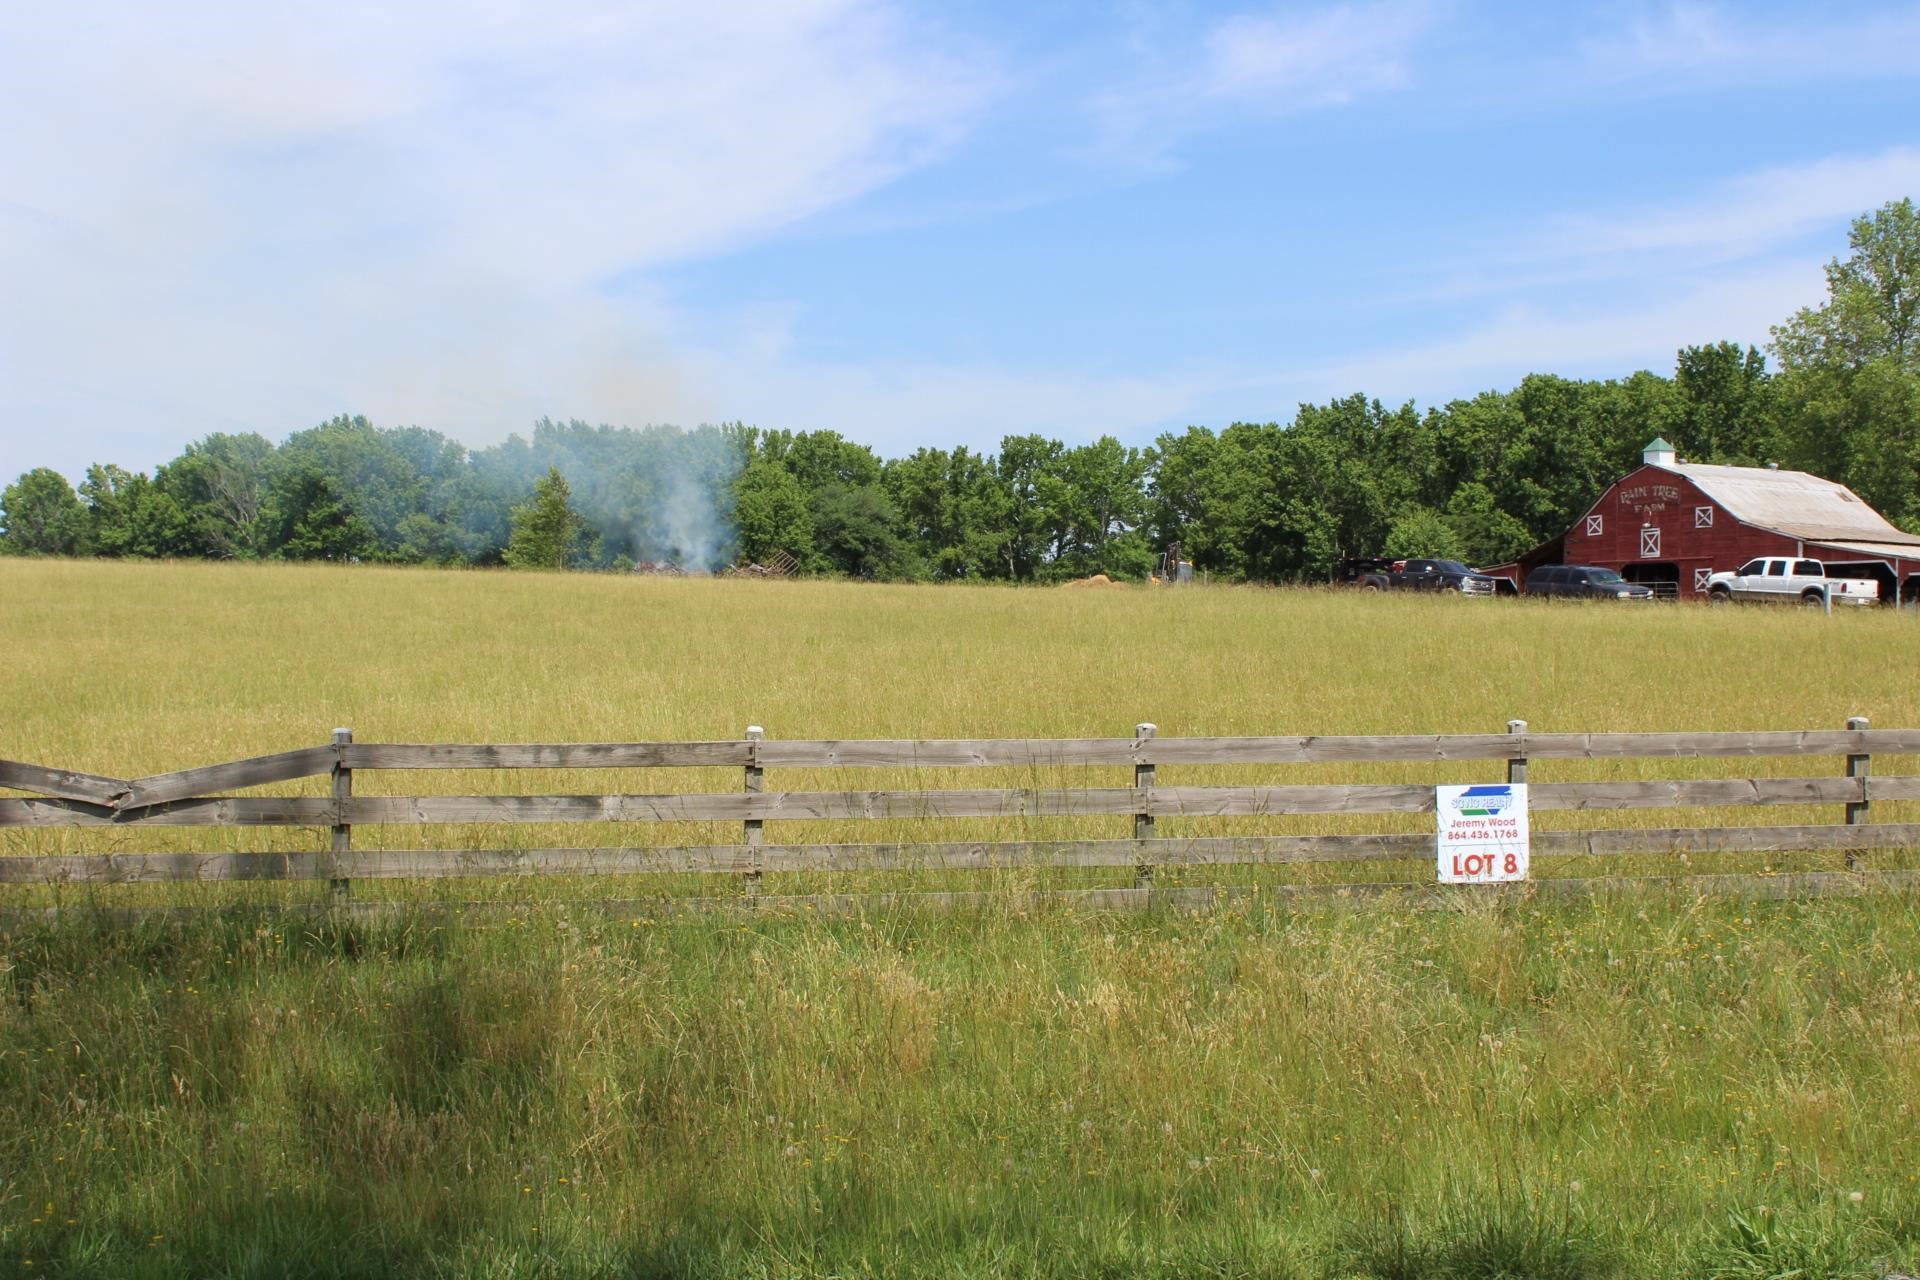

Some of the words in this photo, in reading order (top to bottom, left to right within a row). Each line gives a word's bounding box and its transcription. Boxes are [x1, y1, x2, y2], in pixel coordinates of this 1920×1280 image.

[1620, 487, 1647, 504] RAIN
[1652, 486, 1679, 501] TREE
[1634, 503, 1665, 513] FARM
[1450, 819, 1485, 828] Jeremy
[1488, 817, 1516, 826] Wood
[1448, 830, 1518, 840] 864.436.1768
[1453, 854, 1495, 875] LOT
[1503, 853, 1518, 874] 8
